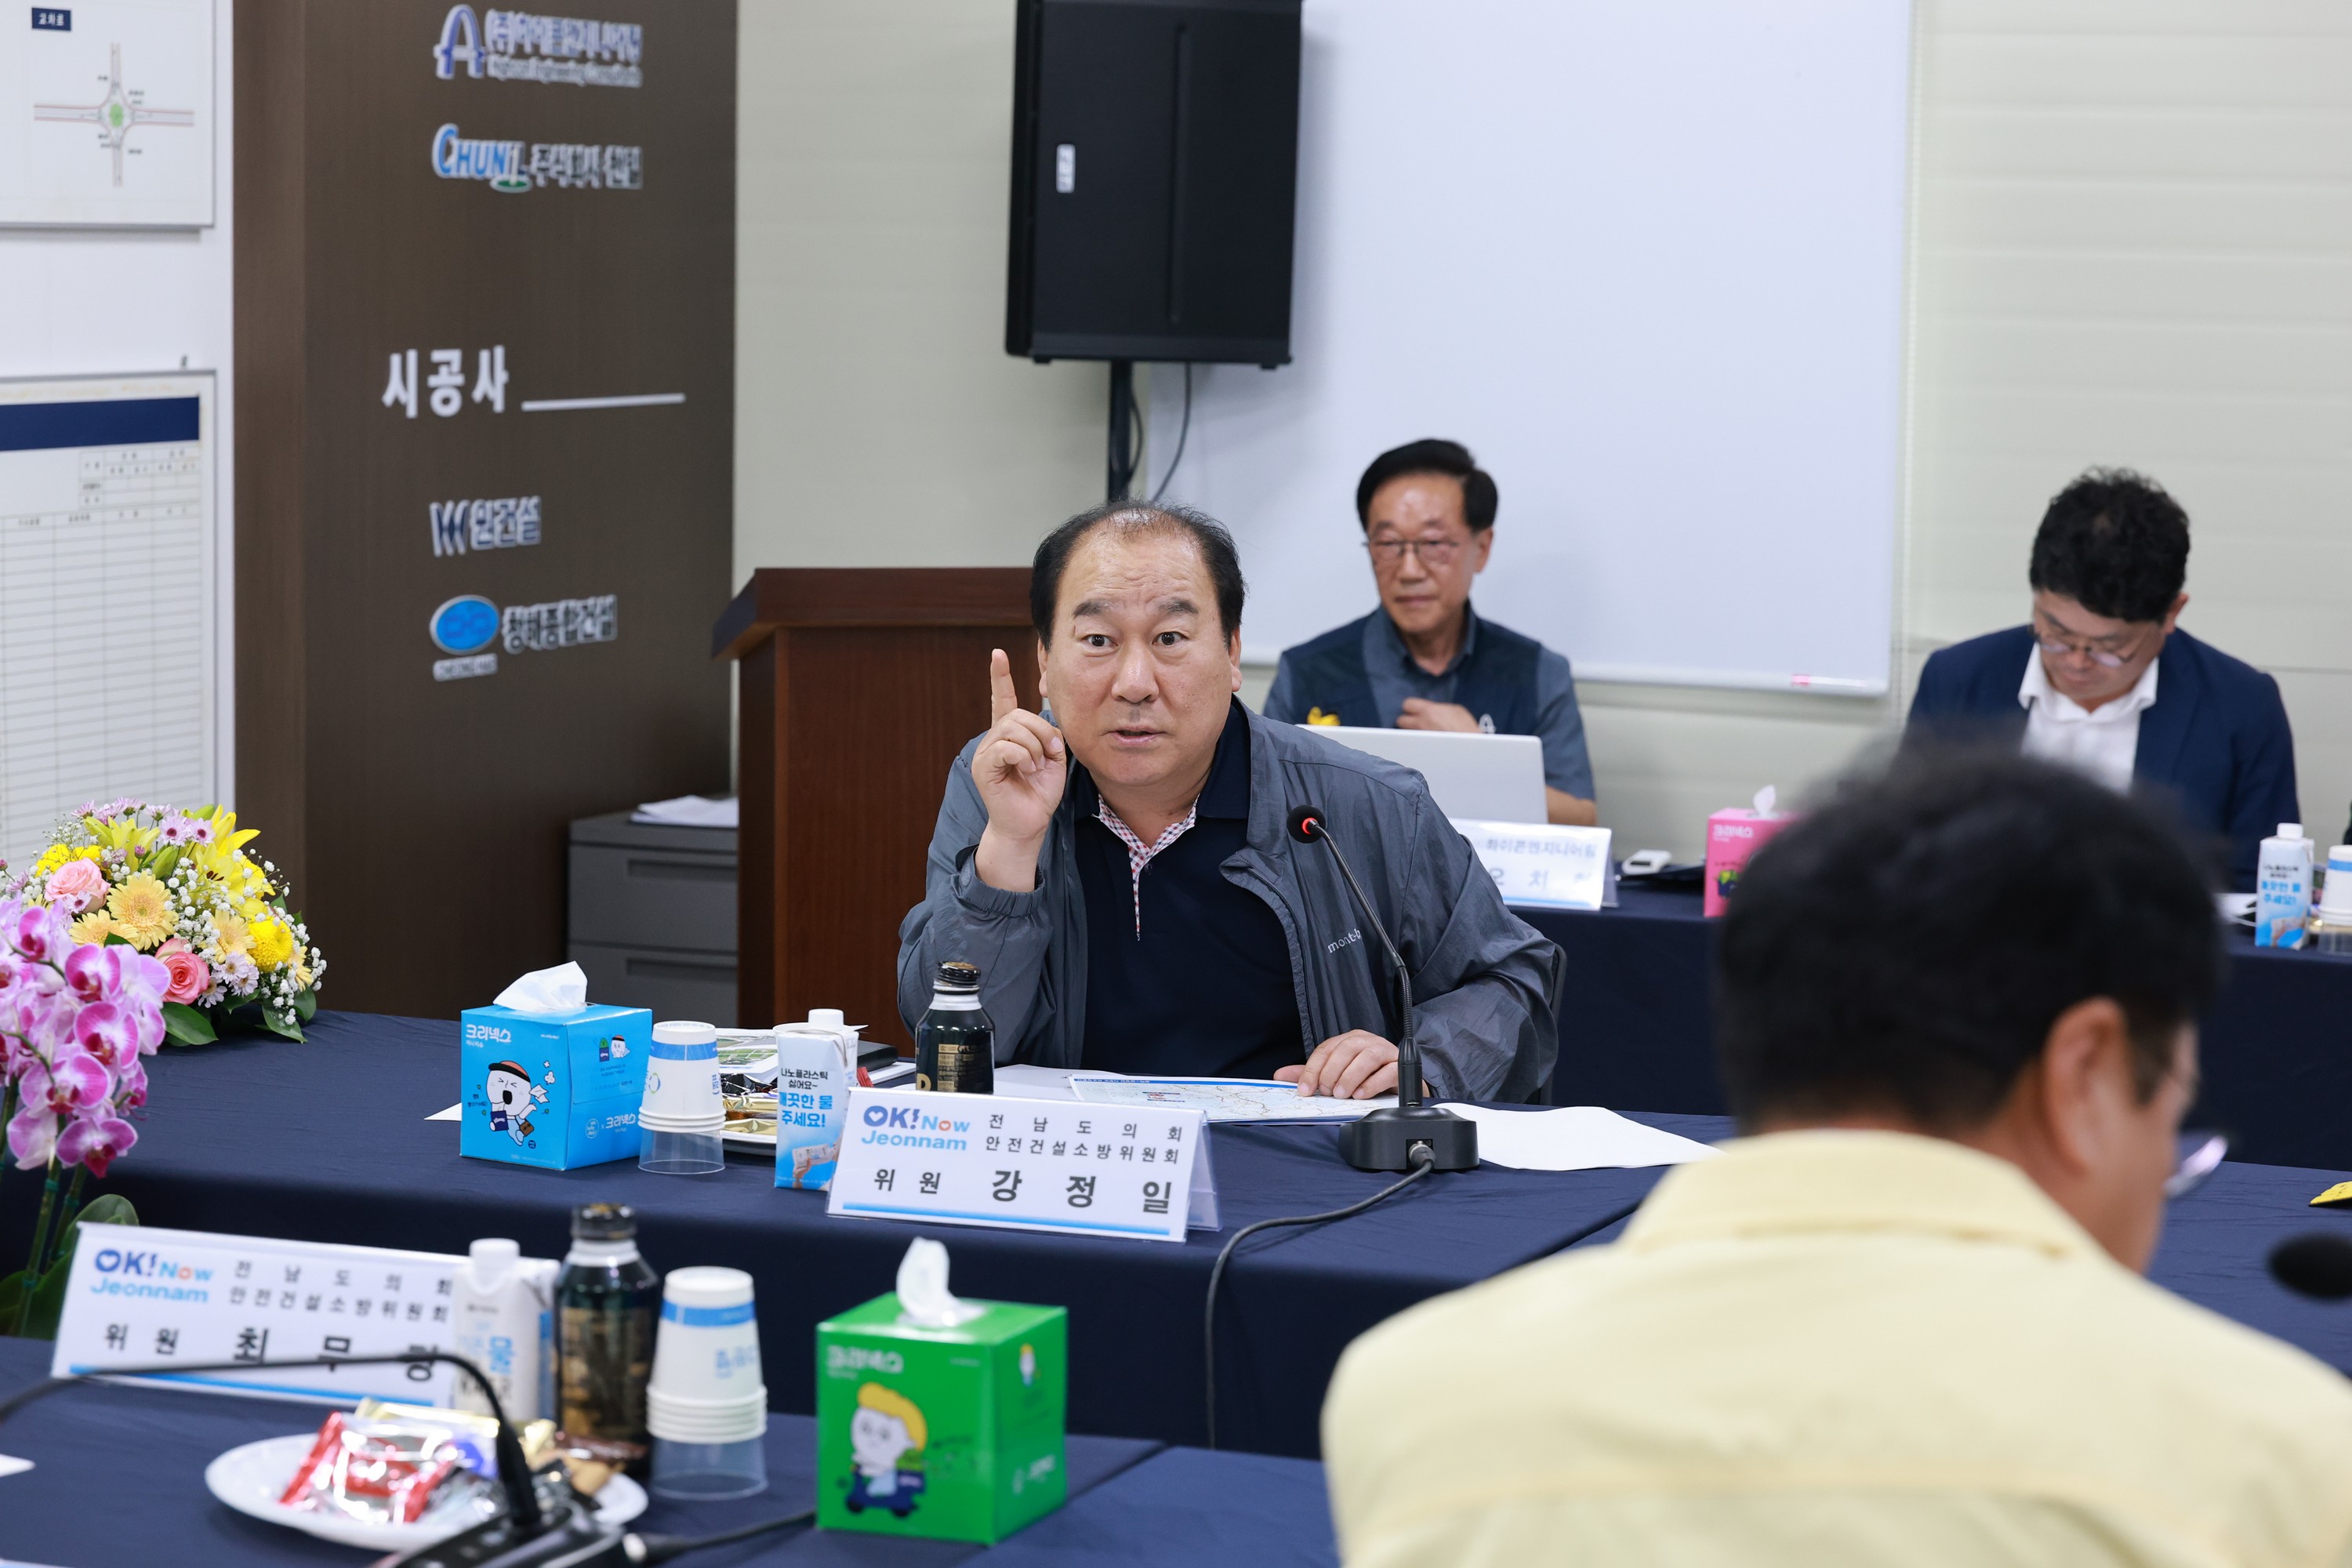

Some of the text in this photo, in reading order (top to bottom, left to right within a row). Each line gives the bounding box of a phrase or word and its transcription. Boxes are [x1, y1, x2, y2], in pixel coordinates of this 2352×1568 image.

[382, 344, 509, 419] 시공사
[471, 496, 541, 550] 원건설
[503, 594, 617, 654] 청해종합건설
[466, 1024, 511, 1043] 크리넥스
[781, 1068, 828, 1080] 나노플라스틱
[789, 1080, 818, 1091] 싫어요~
[818, 1095, 833, 1110] 물
[605, 1113, 636, 1129] 크리넥스
[782, 1110, 826, 1127] 주세요!
[863, 1105, 971, 1133] OK! Now
[861, 1130, 967, 1151] Jeonnam
[985, 1136, 1179, 1164] 안전건설소방위원회
[873, 1168, 1172, 1215] 위원 강정일
[95, 1248, 213, 1282] OK! Now
[90, 1276, 209, 1304] Jeonnam
[104, 1323, 180, 1356] 위원
